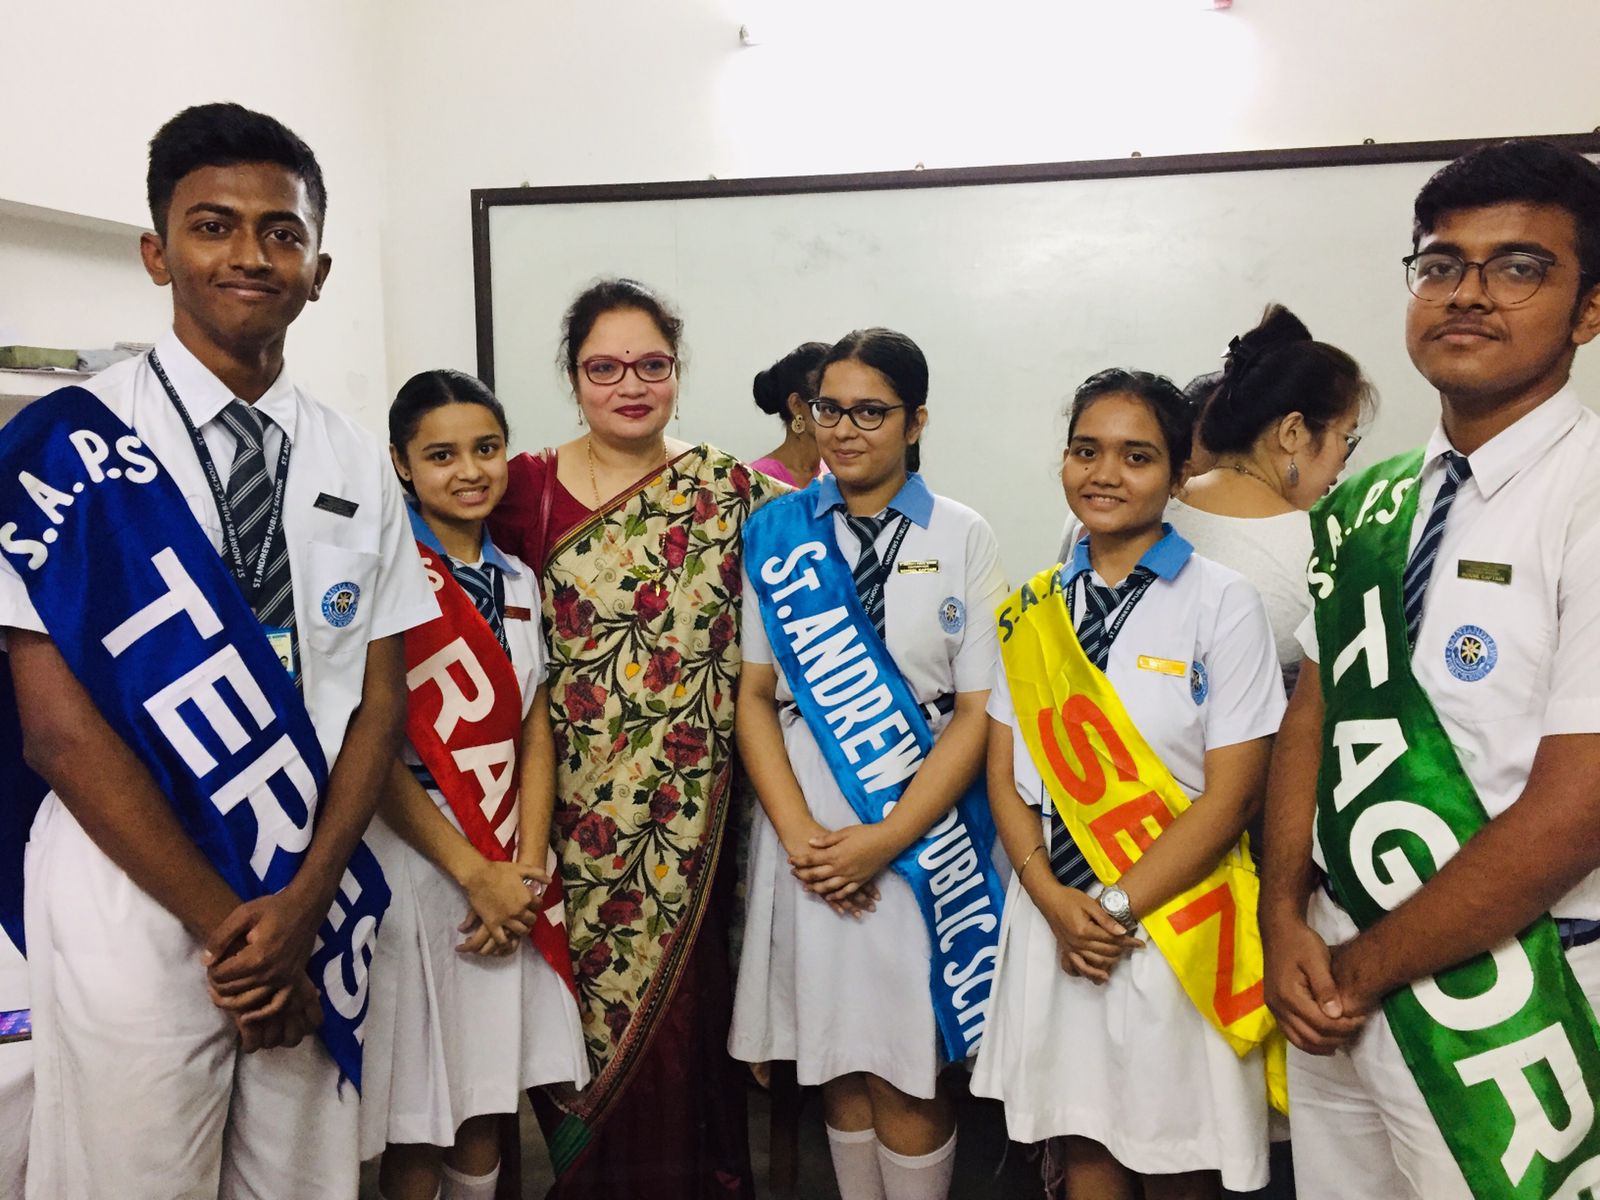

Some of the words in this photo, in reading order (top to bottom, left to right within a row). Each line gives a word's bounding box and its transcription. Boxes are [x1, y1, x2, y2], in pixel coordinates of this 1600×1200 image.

[205, 461, 221, 492] SCHOOL
[274, 478, 284, 507] SCHOOL
[1, 429, 158, 570] S.A.P.S
[218, 493, 233, 523] PUBLIC
[267, 508, 280, 536] PUBLIC
[227, 523, 243, 567] ANDREWS
[256, 536, 273, 576] ANDREWS
[253, 574, 263, 588] ST.
[761, 540, 827, 619] ST.
[867, 583, 880, 605] SCHOOL
[1113, 600, 1137, 630] ANDREWS
[782, 605, 925, 817] ANDREW
[1038, 693, 1263, 1028] SEN
[1333, 584, 1600, 1200] TAGOR
